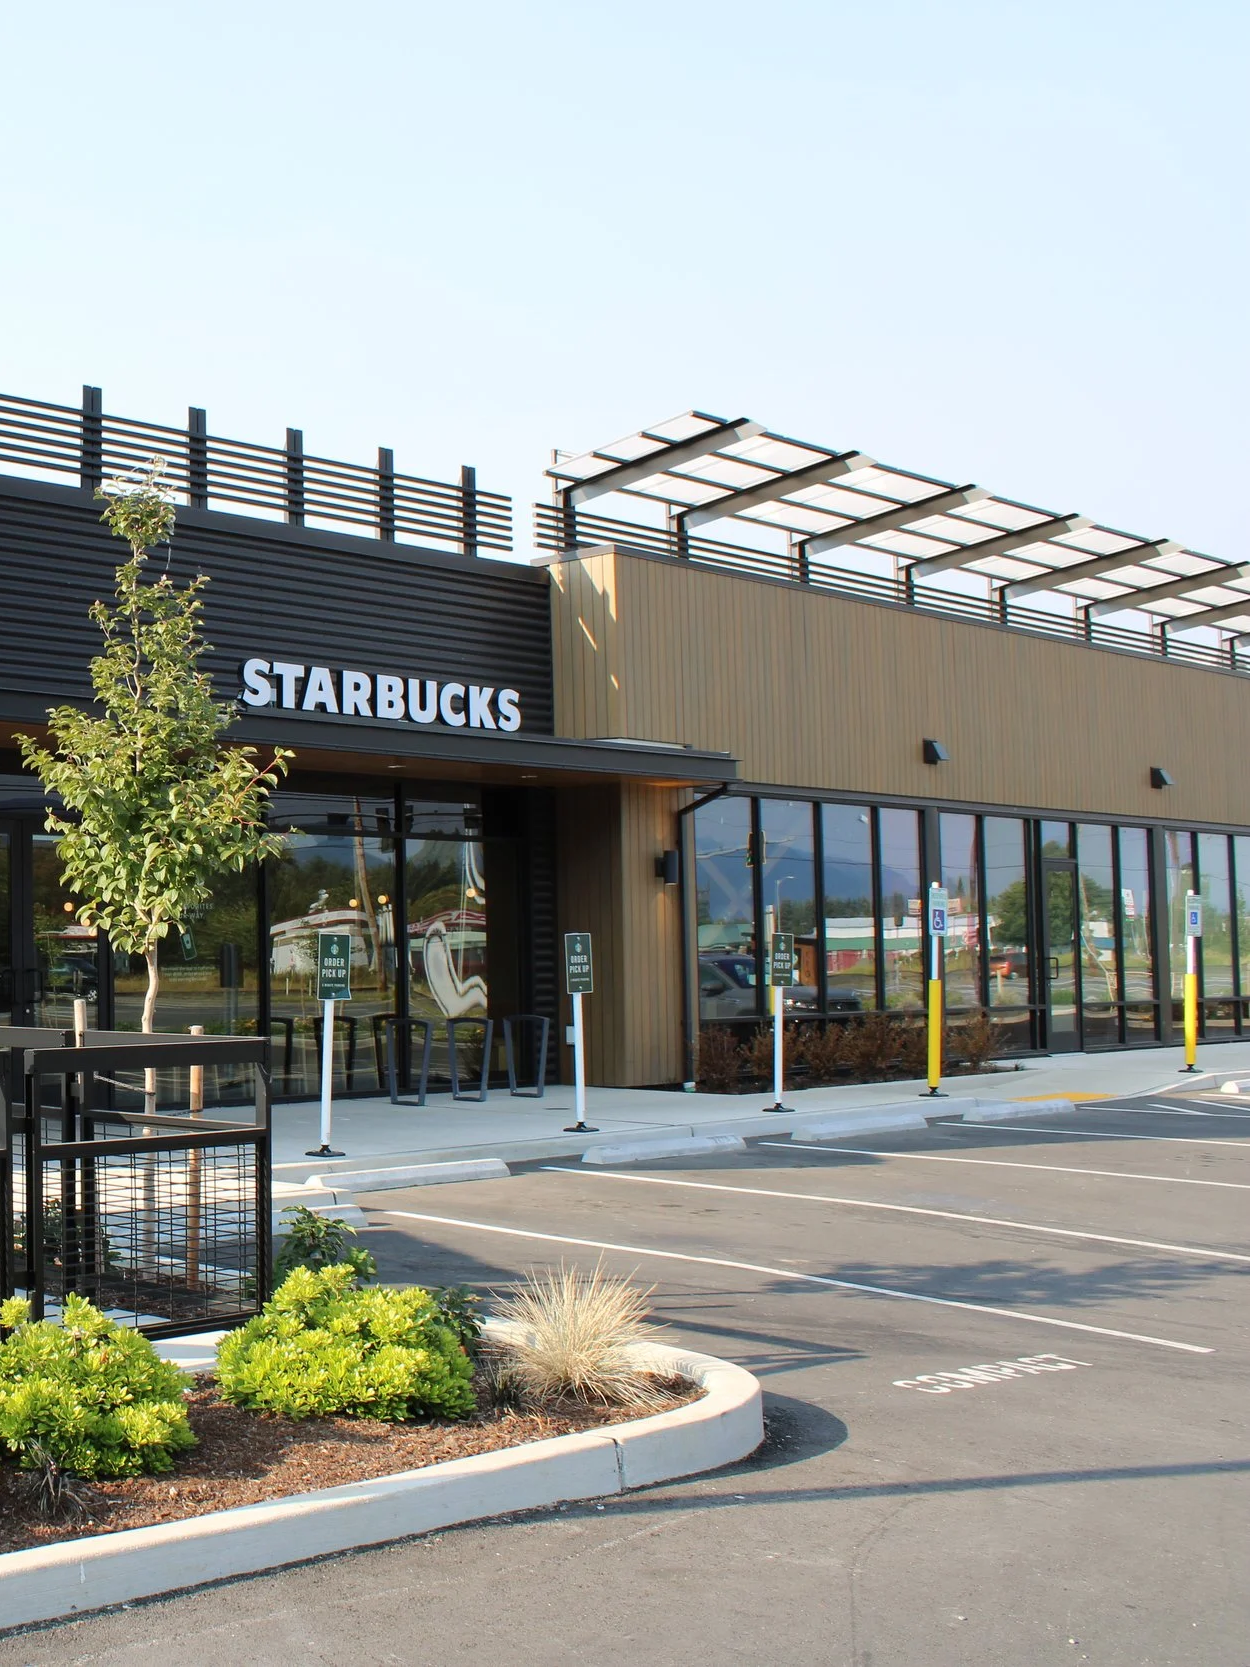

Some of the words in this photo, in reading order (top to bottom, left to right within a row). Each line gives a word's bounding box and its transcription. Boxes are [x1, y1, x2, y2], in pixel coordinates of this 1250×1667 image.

[239, 658, 522, 732] STARBUCKS
[570, 955, 588, 964] ORDER
[774, 952, 790, 961] ORDER
[323, 957, 345, 967] ORDER
[773, 961, 784, 969] PICK
[784, 961, 792, 969] UP
[321, 968, 336, 978] PICK
[337, 968, 347, 978] UP
[569, 965, 582, 974] PICK
[582, 965, 590, 973] UP
[892, 1353, 1094, 1394] COMPACT
